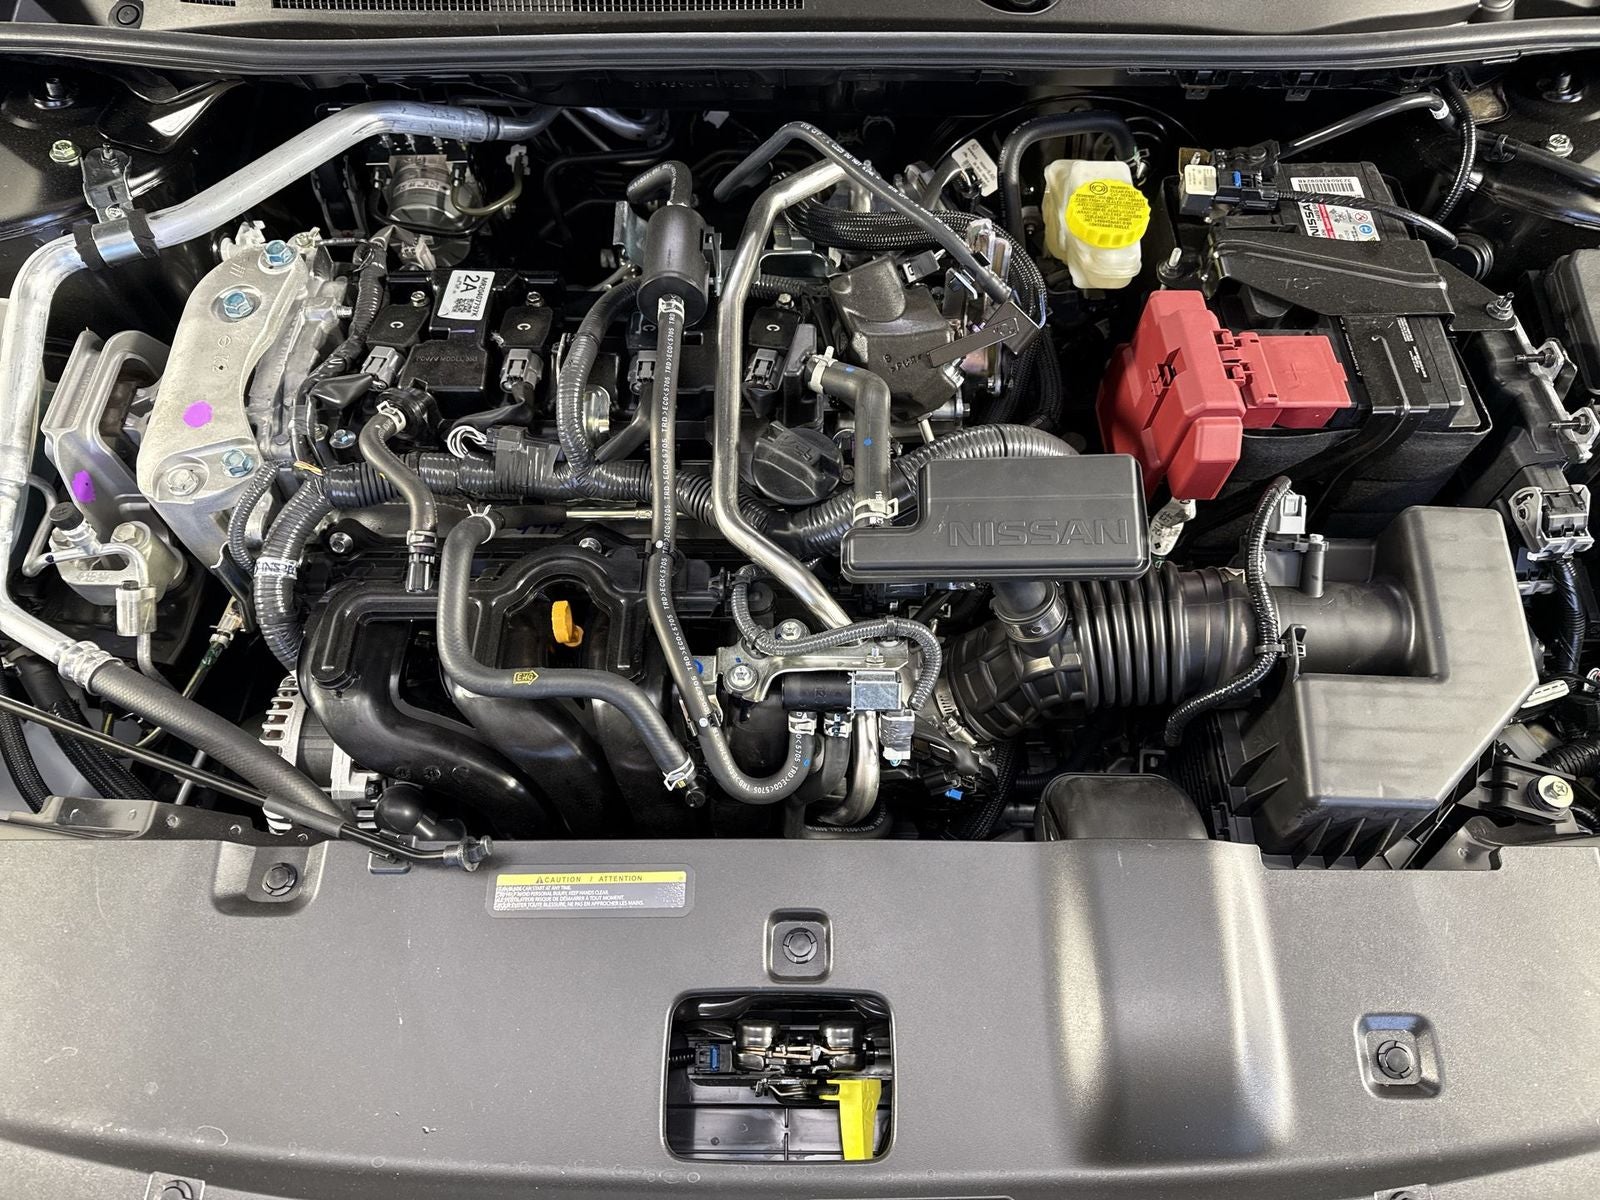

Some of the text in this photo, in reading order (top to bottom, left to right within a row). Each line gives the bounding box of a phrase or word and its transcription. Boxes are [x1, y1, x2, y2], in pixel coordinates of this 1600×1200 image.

[1303, 201, 1320, 236] NISSA
[460, 274, 481, 293] 2A
[949, 519, 1129, 547] NISSAN
